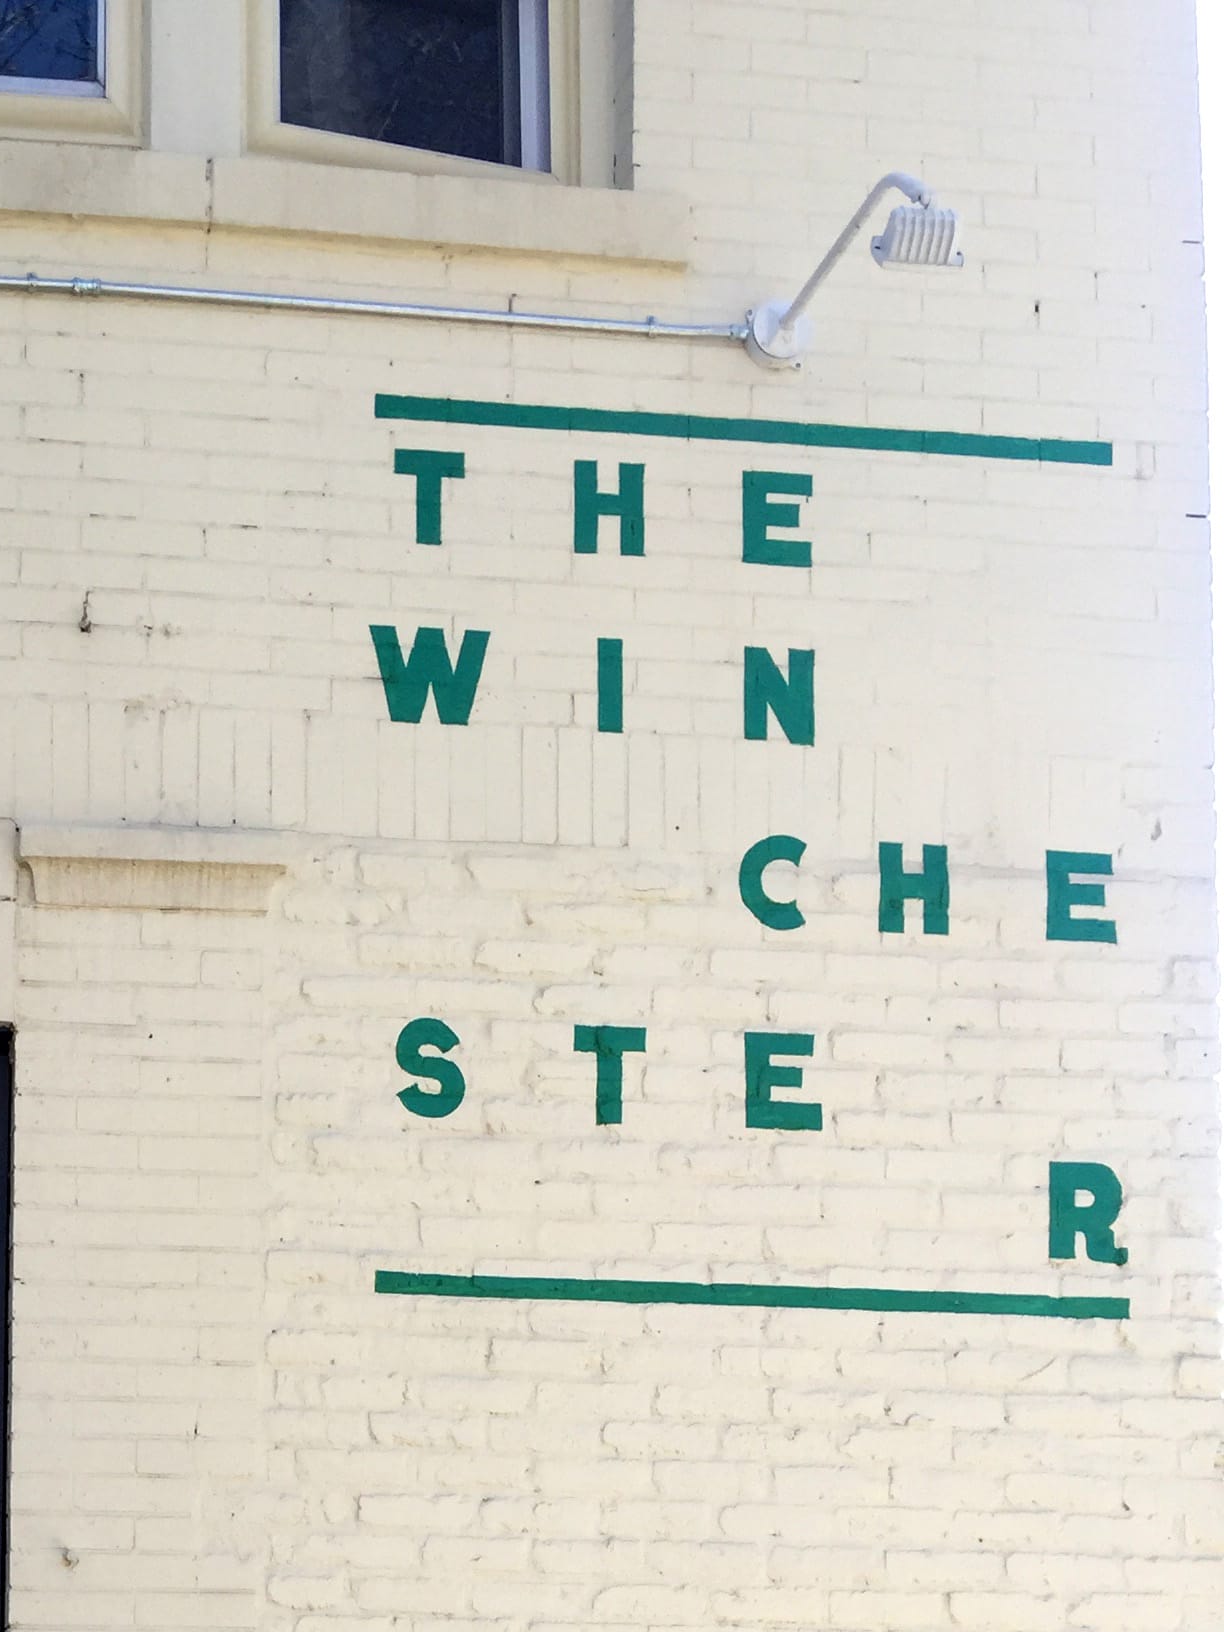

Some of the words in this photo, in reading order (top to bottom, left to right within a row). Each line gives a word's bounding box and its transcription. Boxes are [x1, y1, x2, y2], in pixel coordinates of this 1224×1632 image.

[394, 449, 813, 567] THE
[369, 625, 815, 746] WIN
[738, 834, 1117, 944] CHE
[395, 1017, 823, 1131] STE
[1048, 1161, 1129, 1266] R
